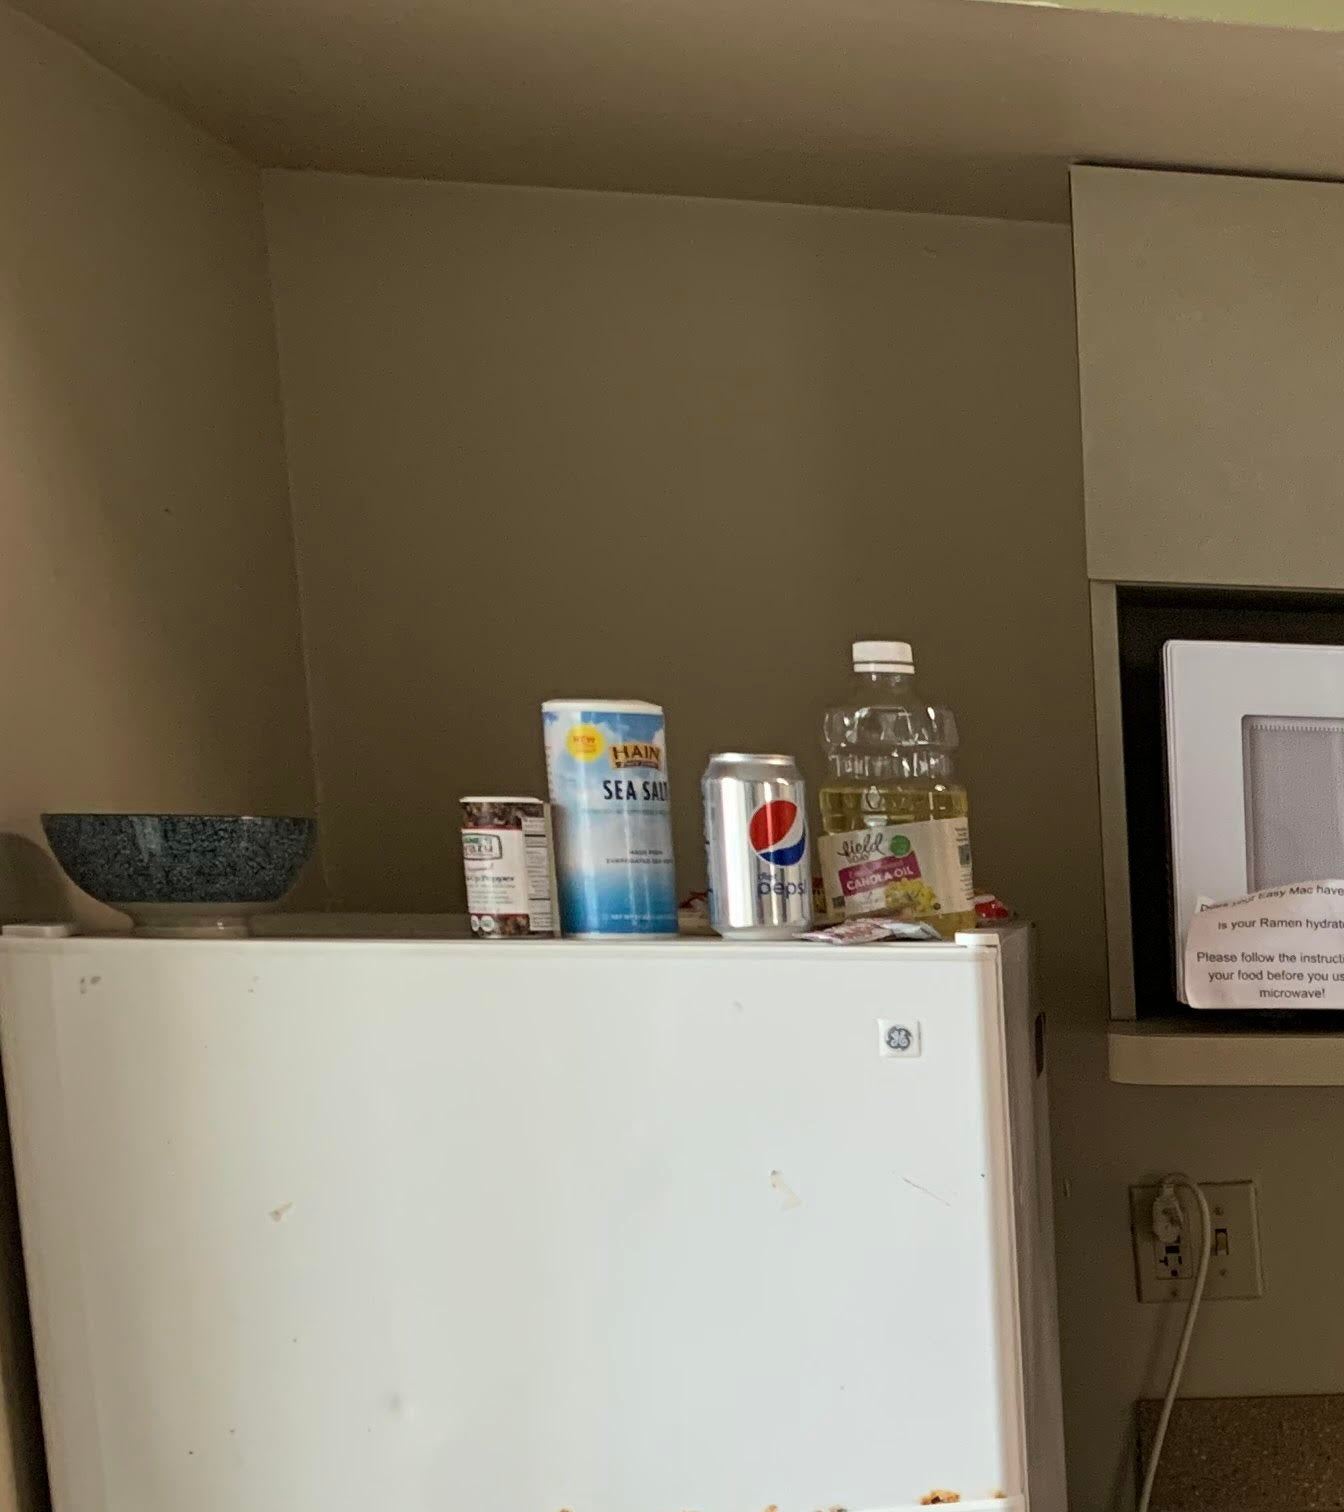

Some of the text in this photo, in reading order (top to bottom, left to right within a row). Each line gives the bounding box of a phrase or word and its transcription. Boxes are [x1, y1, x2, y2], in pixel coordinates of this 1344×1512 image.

[612, 744, 659, 760] HAIN
[603, 780, 637, 801] SEA
[846, 872, 893, 890] CANOLA
[894, 866, 914, 877] OIL
[1258, 889, 1285, 900] Easy
[1289, 886, 1313, 895] Mac
[1316, 885, 1344, 897] have
[1231, 919, 1256, 930] your
[1260, 917, 1302, 928] Ramen
[1196, 951, 1237, 963] Please
[1241, 951, 1274, 963] follow
[1278, 952, 1297, 963] the
[1208, 970, 1234, 982] your
[1237, 969, 1263, 981] food
[1267, 969, 1304, 981] before
[1307, 971, 1329, 983] you
[1259, 988, 1326, 999] microwave!
